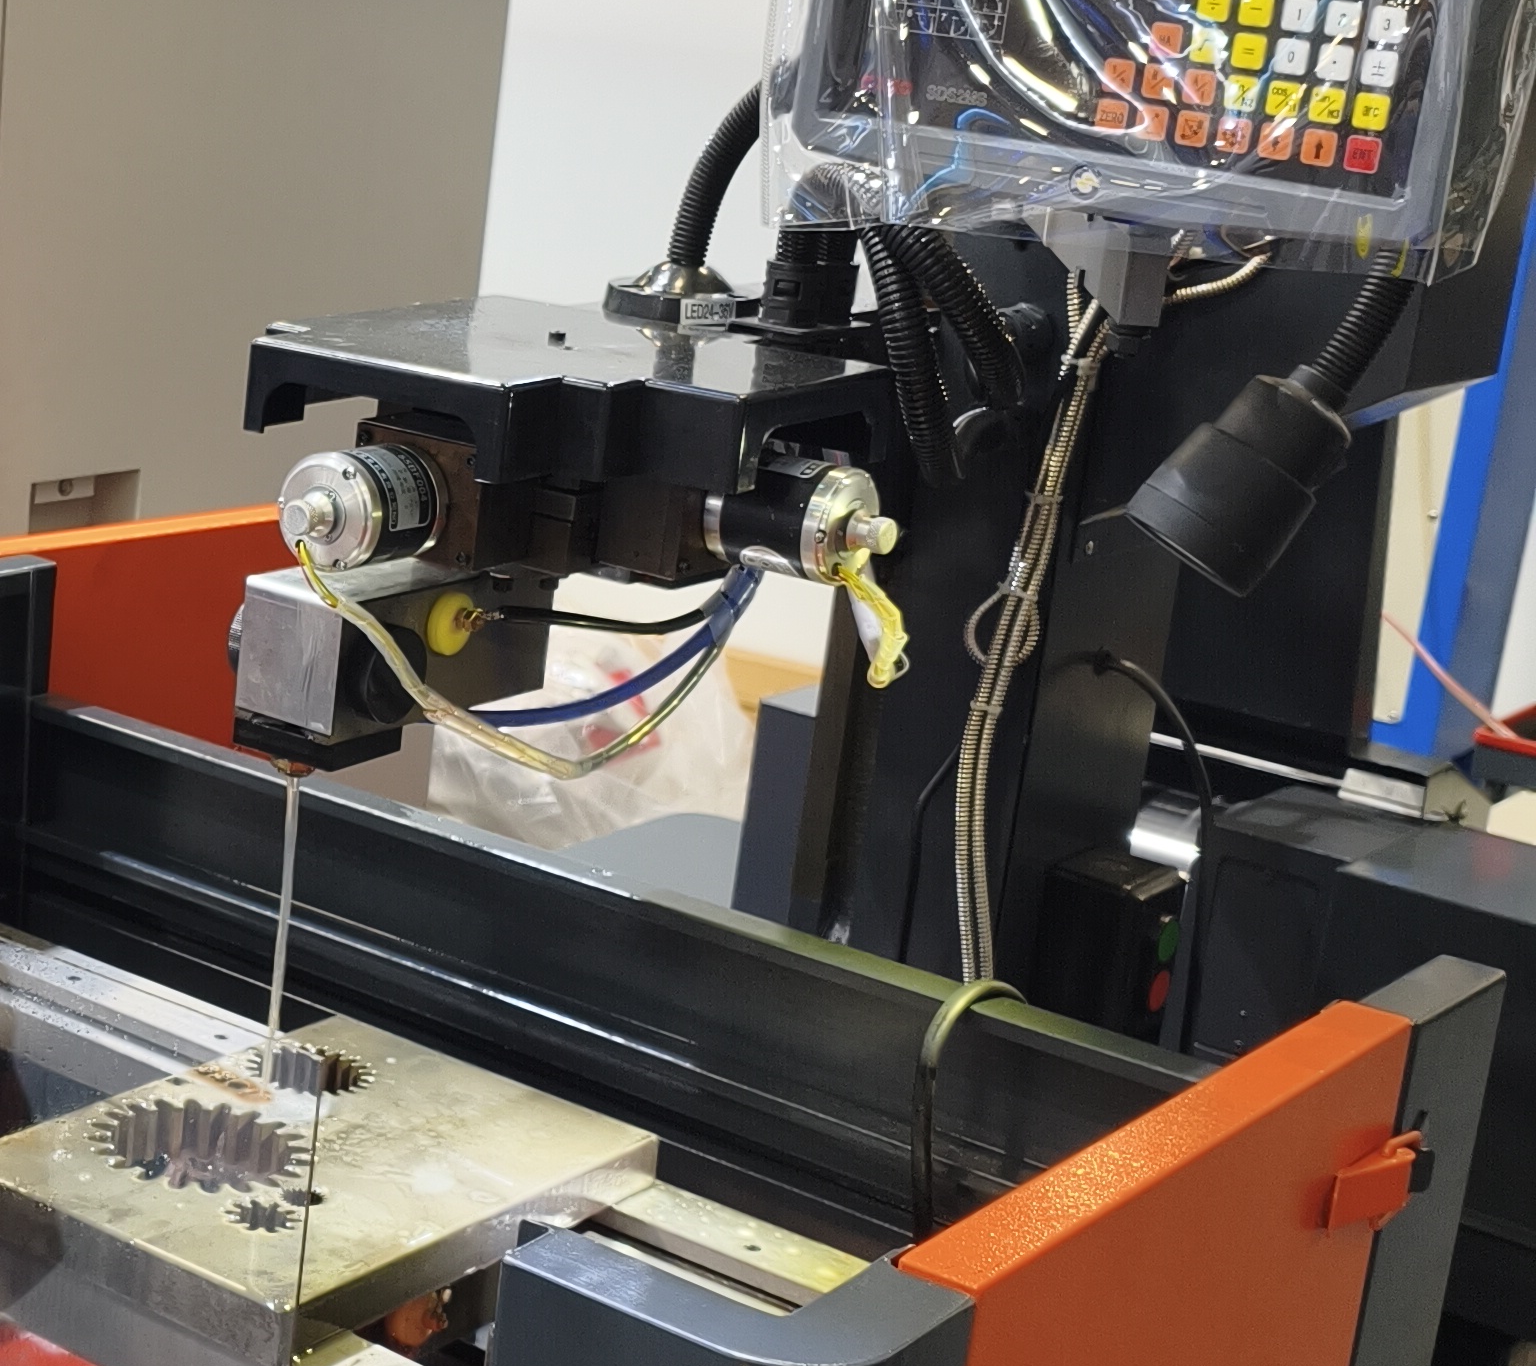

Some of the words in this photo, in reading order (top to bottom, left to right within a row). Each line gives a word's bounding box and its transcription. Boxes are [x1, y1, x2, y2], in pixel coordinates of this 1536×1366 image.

[1382, 18, 1391, 31] 3
[1286, 50, 1295, 64] 0
[1098, 109, 1125, 125] ZERO
